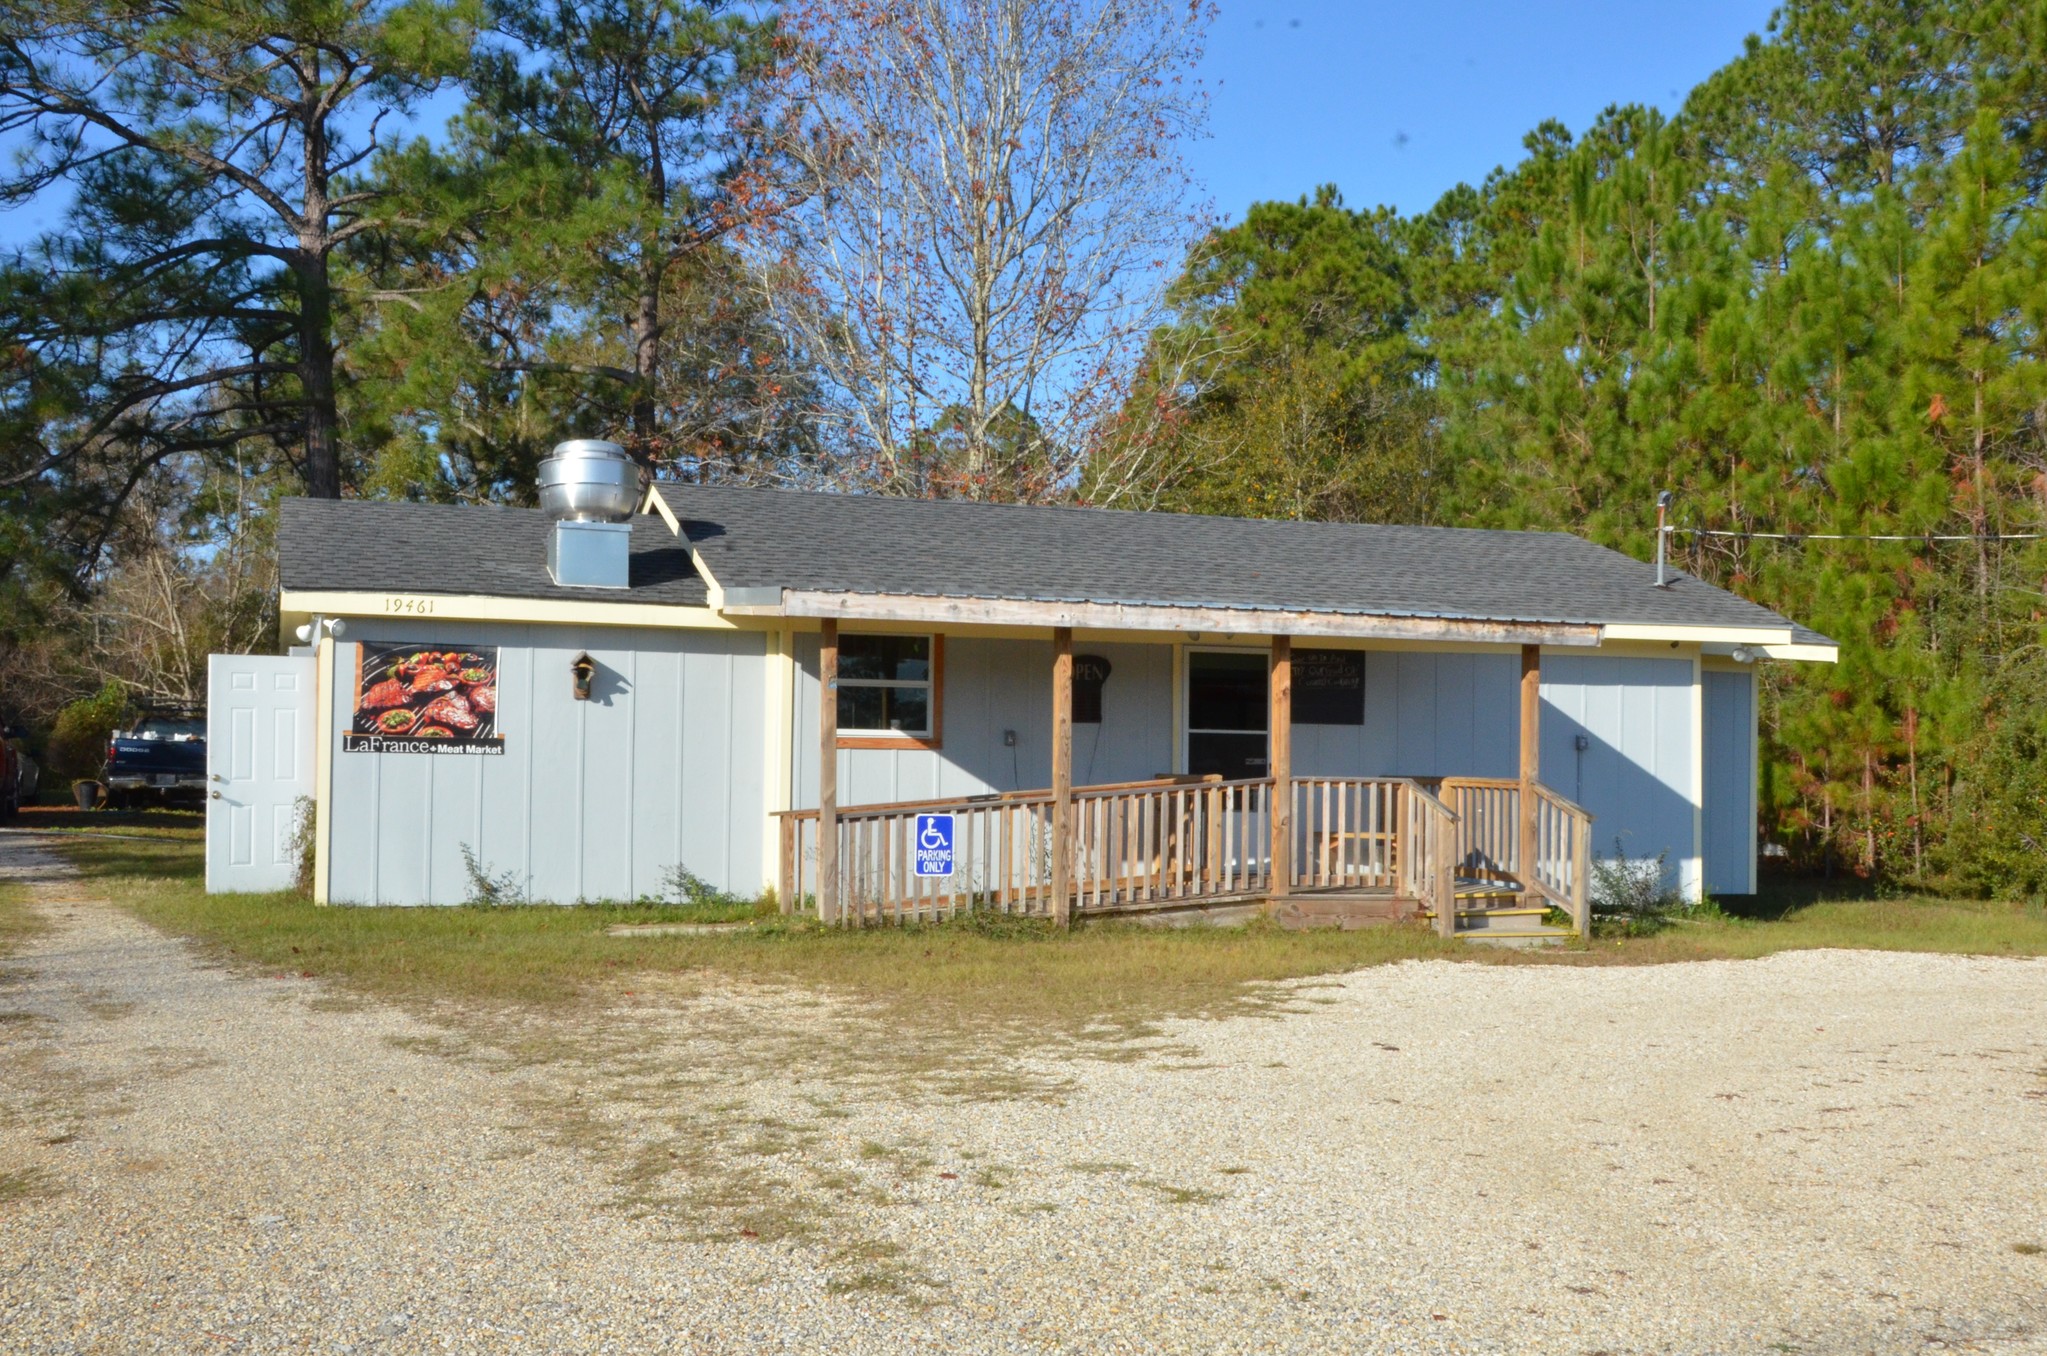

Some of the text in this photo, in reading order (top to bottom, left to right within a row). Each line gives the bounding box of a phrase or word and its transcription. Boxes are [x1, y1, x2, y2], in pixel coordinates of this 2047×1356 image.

[385, 598, 434, 614] 19461
[345, 736, 502, 755] LaFrance Meat Market
[917, 849, 952, 862] PARKING
[923, 861, 946, 873] ONLY
